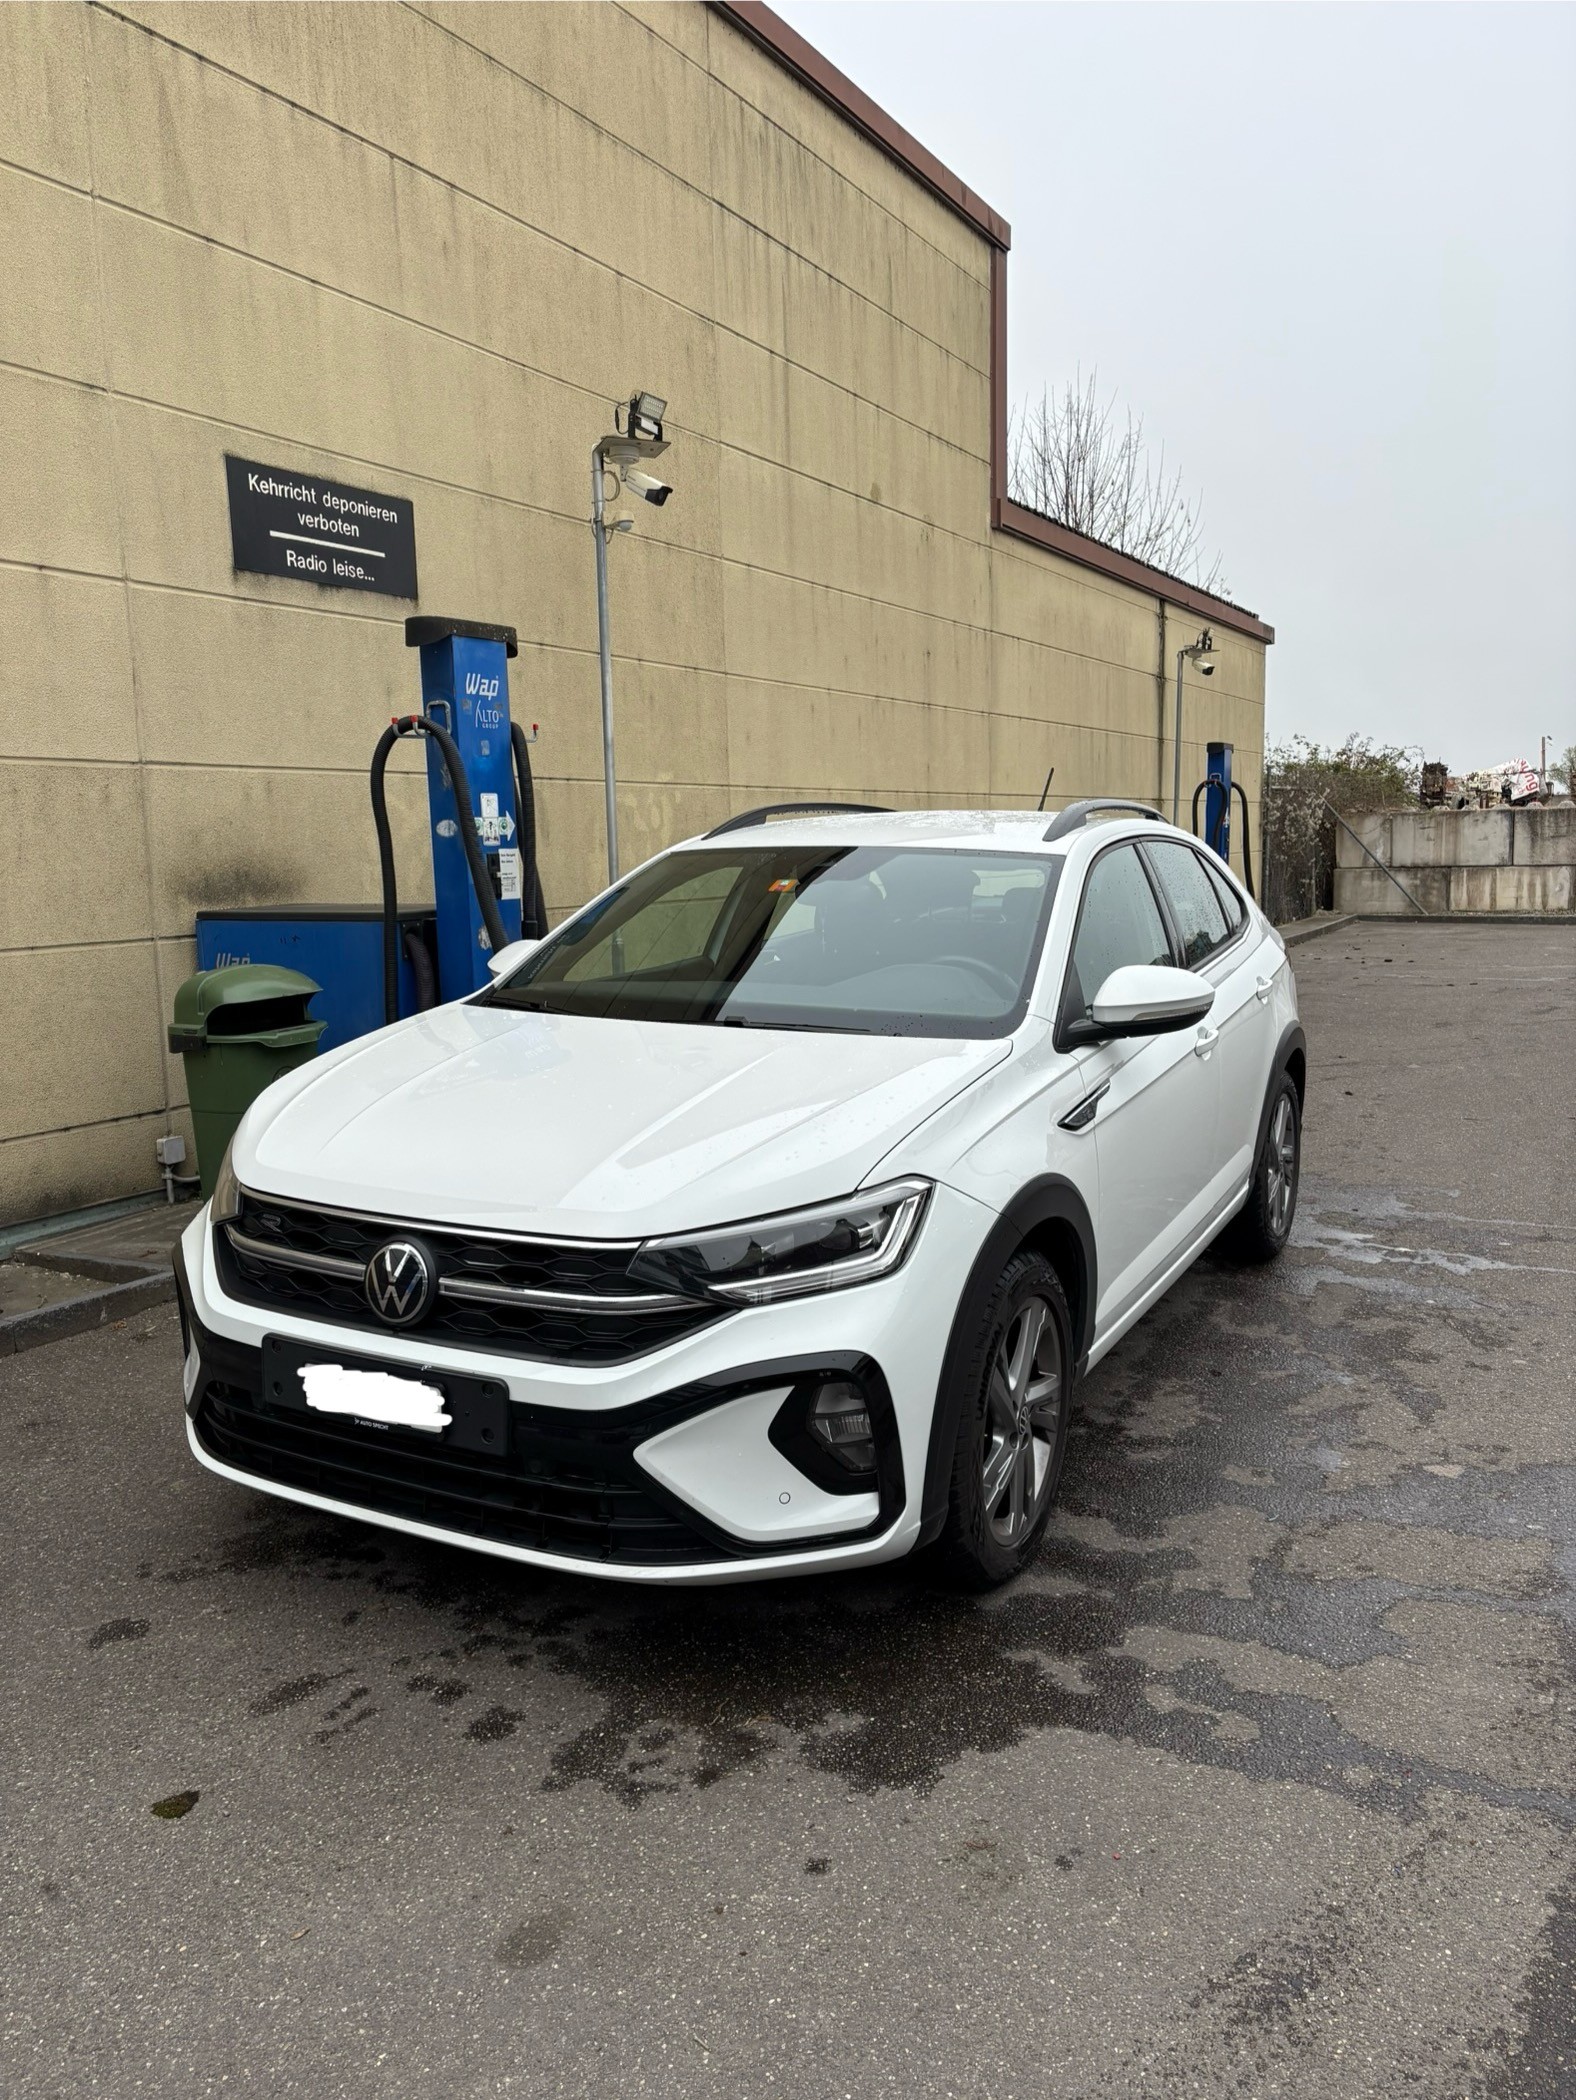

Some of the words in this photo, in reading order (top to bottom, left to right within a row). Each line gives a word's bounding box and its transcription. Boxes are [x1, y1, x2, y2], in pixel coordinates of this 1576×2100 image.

[248, 473, 317, 504] Kehrricht
[323, 491, 398, 523] deponieren
[298, 513, 360, 537] verboten
[286, 550, 327, 573] Radio
[333, 558, 375, 581] leise...
[466, 673, 499, 700] Wap
